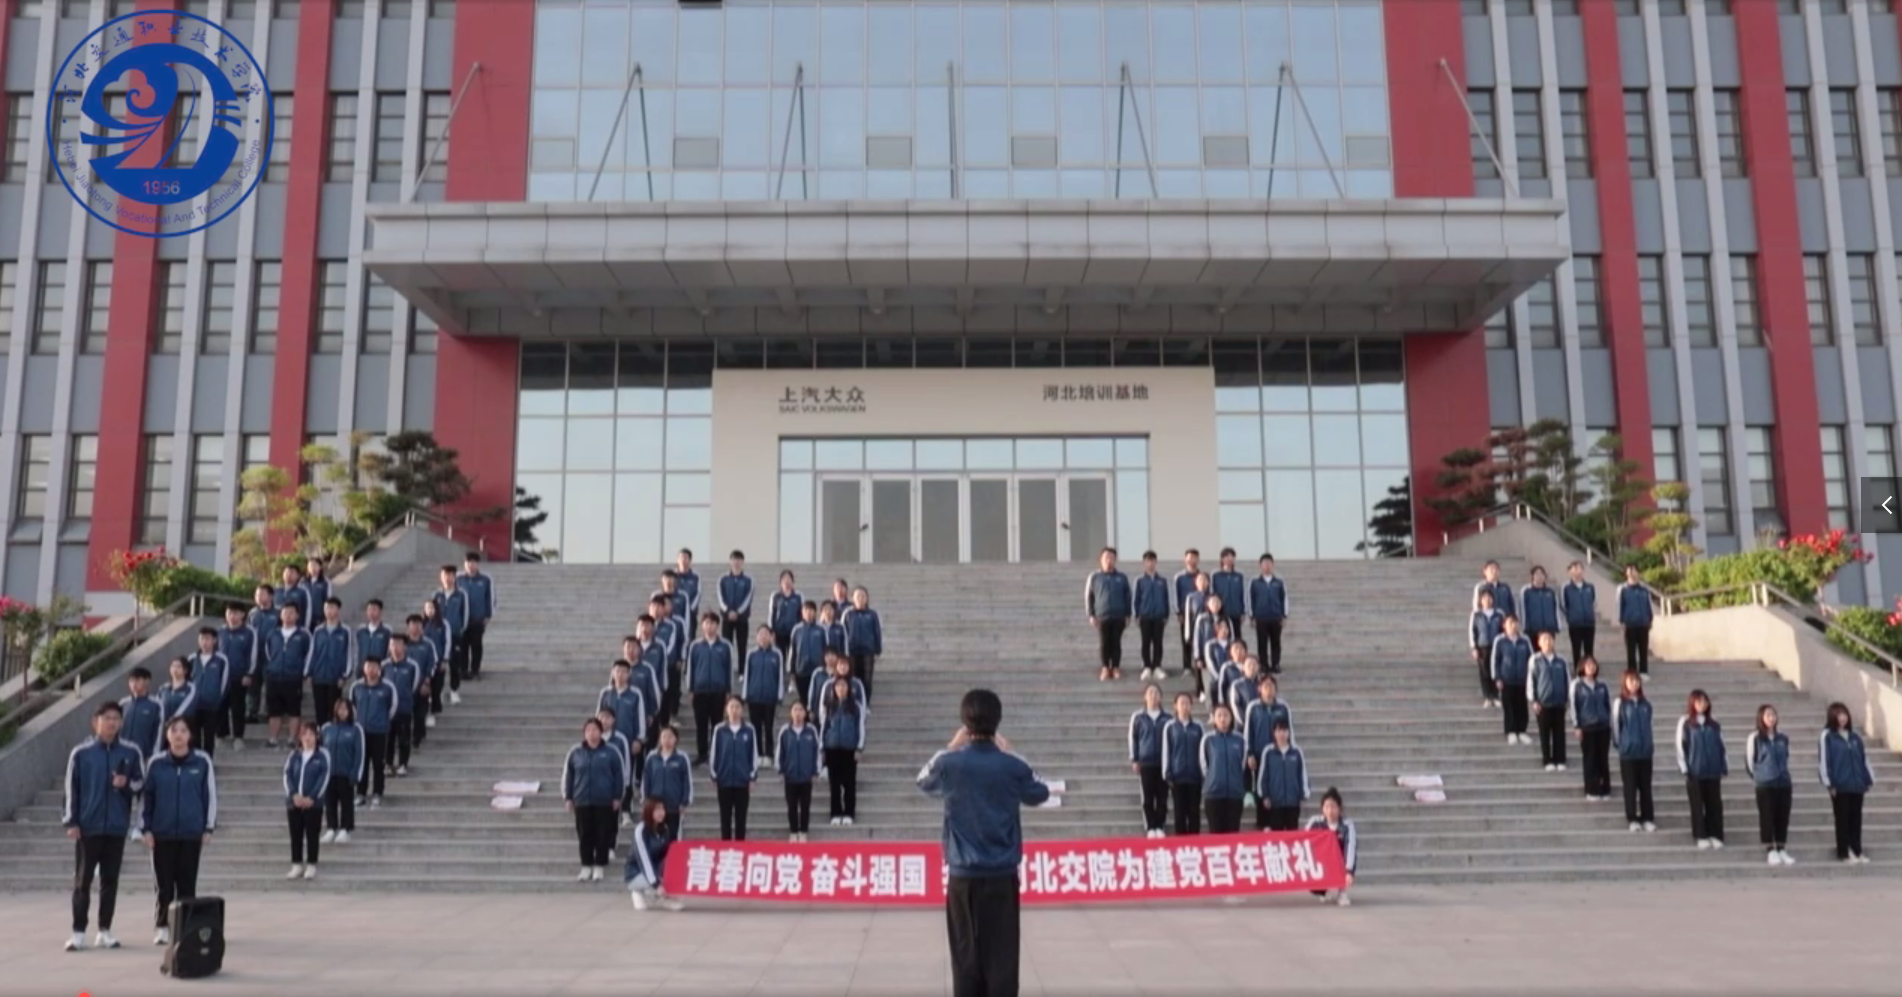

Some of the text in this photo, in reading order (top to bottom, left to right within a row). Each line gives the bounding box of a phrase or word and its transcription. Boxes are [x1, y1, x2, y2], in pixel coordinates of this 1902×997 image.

[778, 385, 866, 404] 上汽大众
[1042, 383, 1150, 402] 河北培训基地
[686, 846, 803, 894] 青春向党
[810, 853, 927, 897] 奋斗强国
